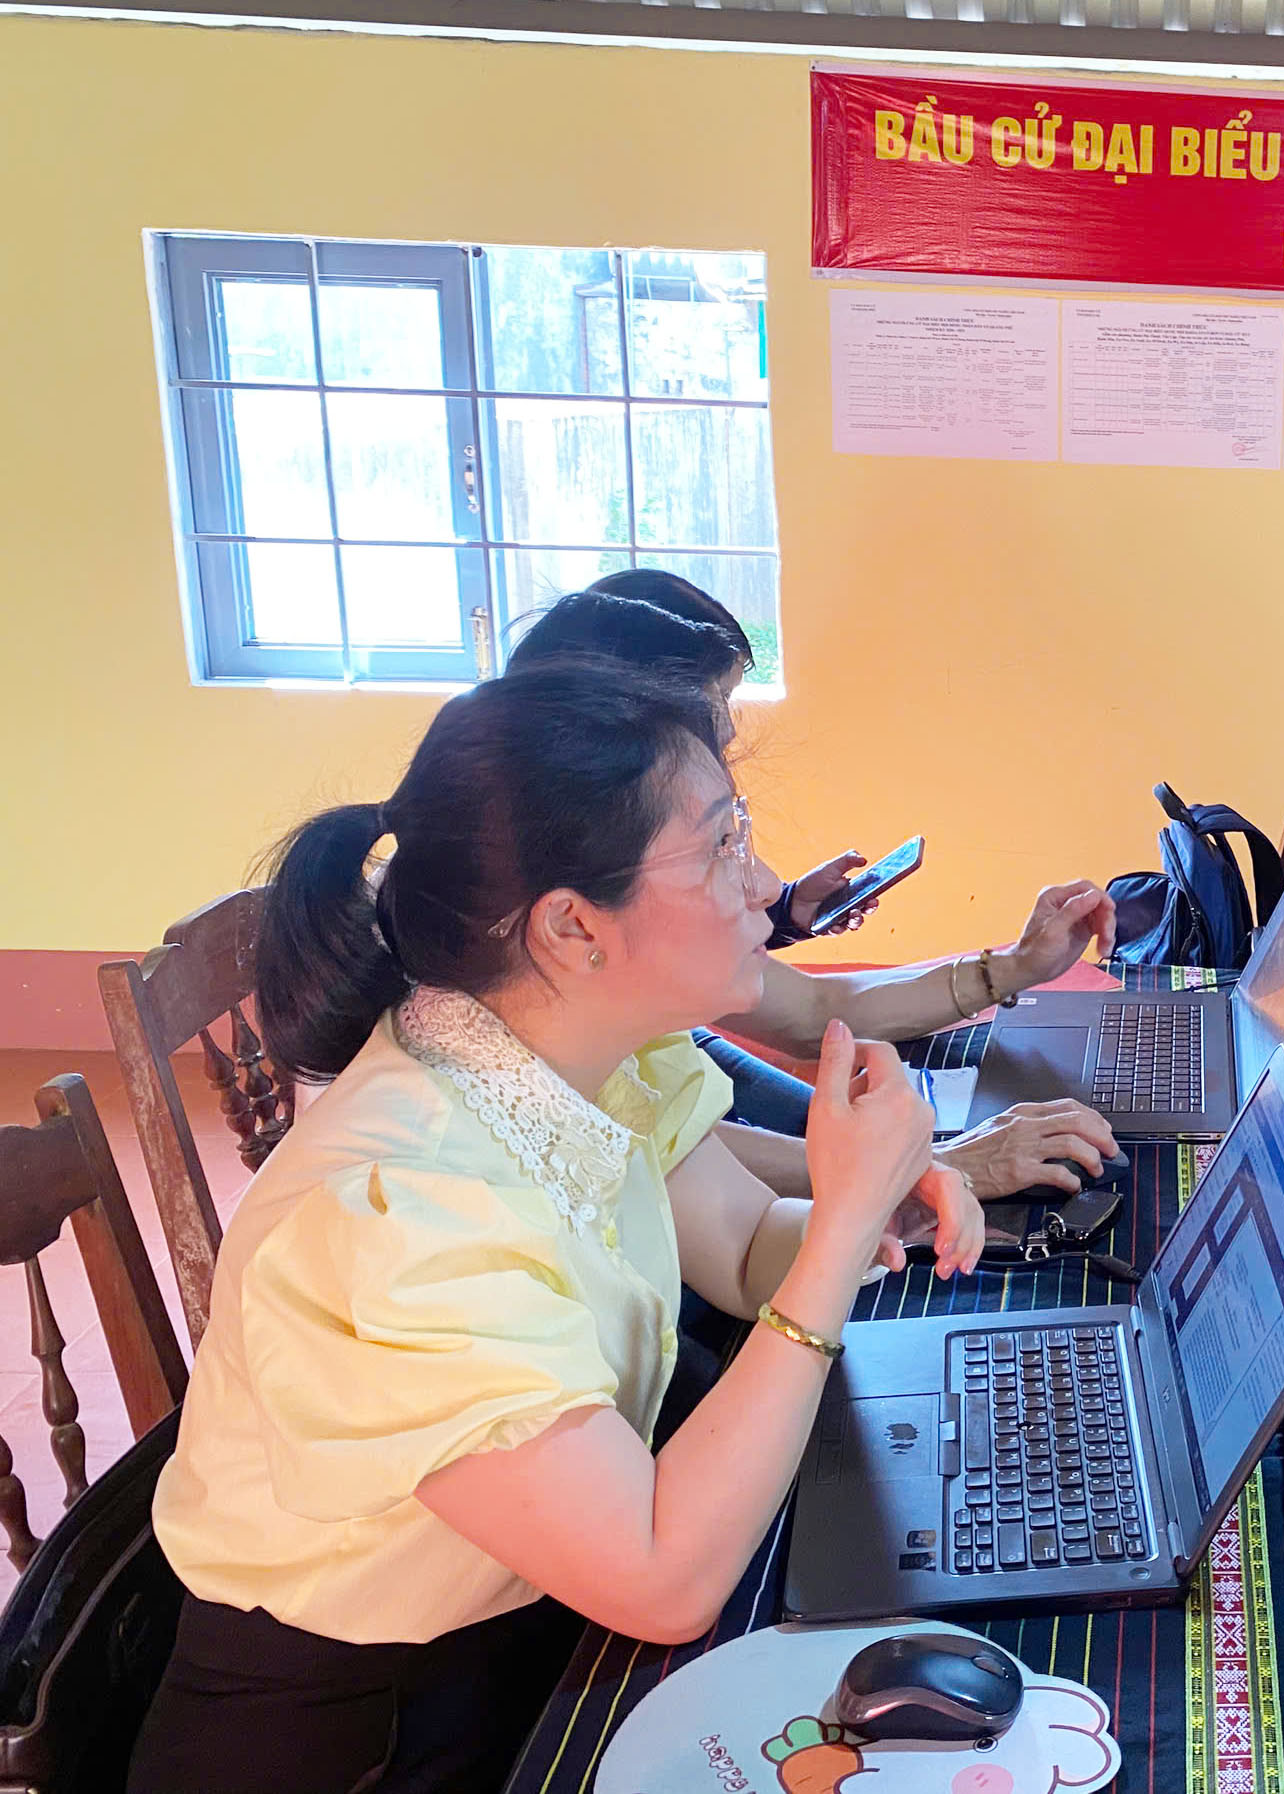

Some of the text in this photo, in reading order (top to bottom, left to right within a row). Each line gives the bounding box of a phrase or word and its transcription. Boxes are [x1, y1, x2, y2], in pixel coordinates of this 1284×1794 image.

[875, 95, 974, 165] BẦU
[991, 101, 1063, 170] CỬ
[1071, 121, 1154, 184] ĐẠI
[1170, 110, 1281, 181] BIỂU
[699, 1733, 749, 1793] happy
